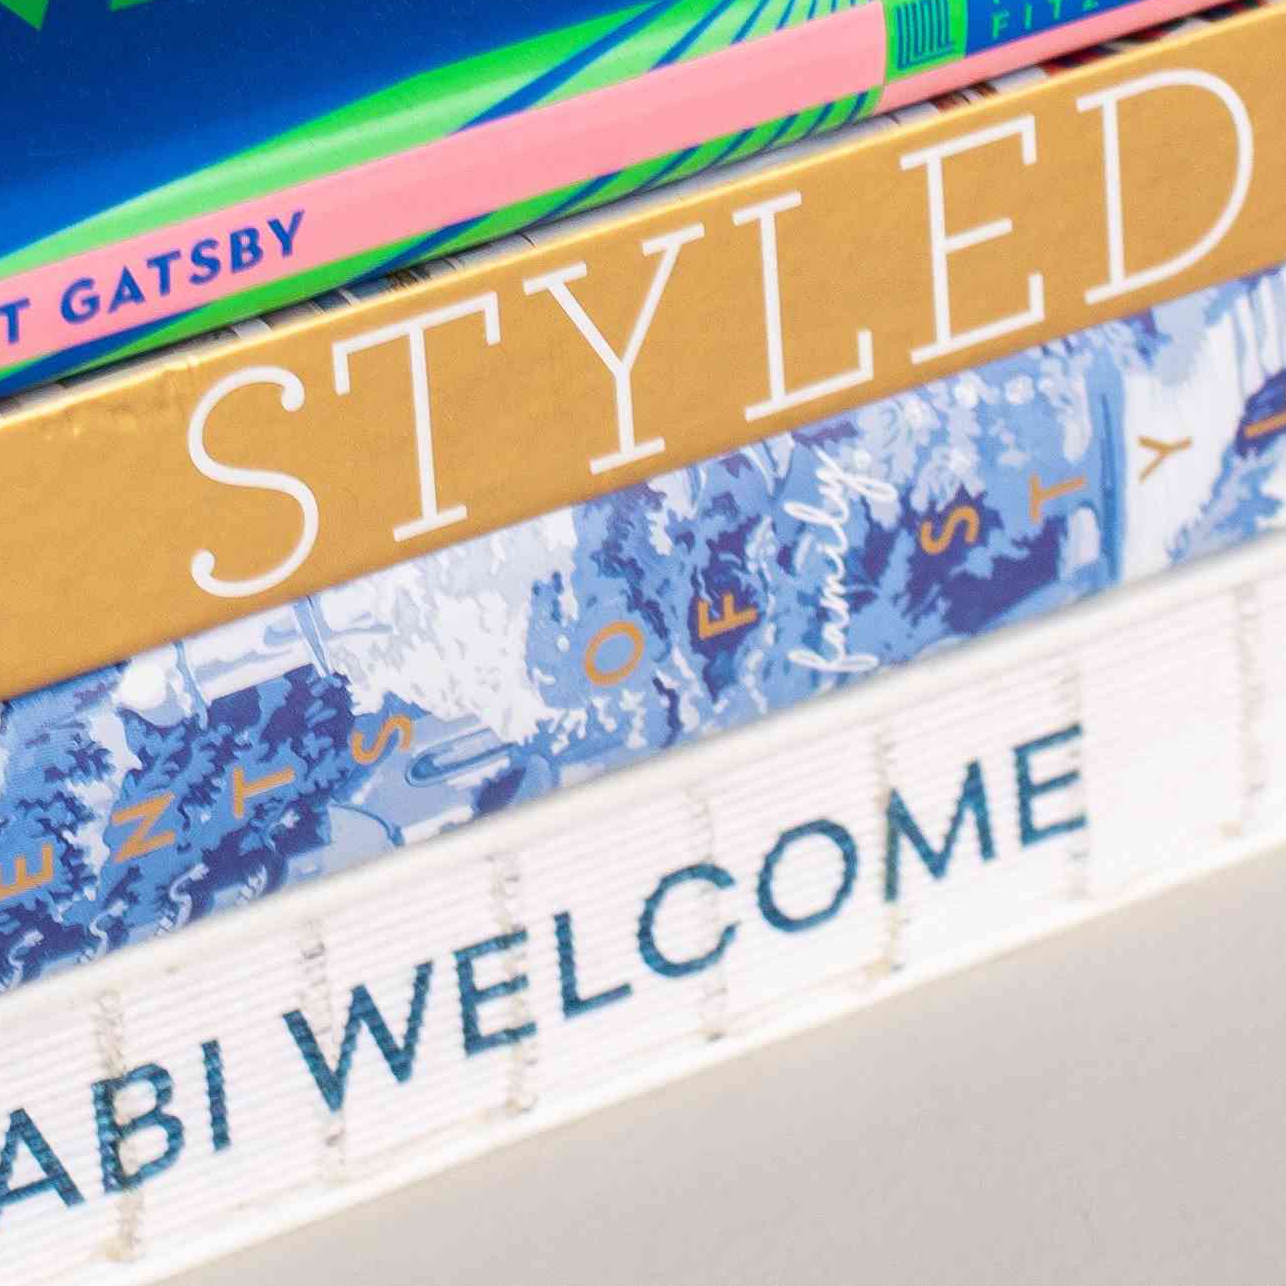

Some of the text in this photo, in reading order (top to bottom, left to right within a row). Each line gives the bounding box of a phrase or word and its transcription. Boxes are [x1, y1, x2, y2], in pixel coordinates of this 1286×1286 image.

[59, 209, 307, 323] GATSBY
[187, 68, 1254, 598] STYLED
[583, 595, 760, 689] OF
[782, 444, 899, 672] family
[284, 721, 1086, 1111] WELCOME
